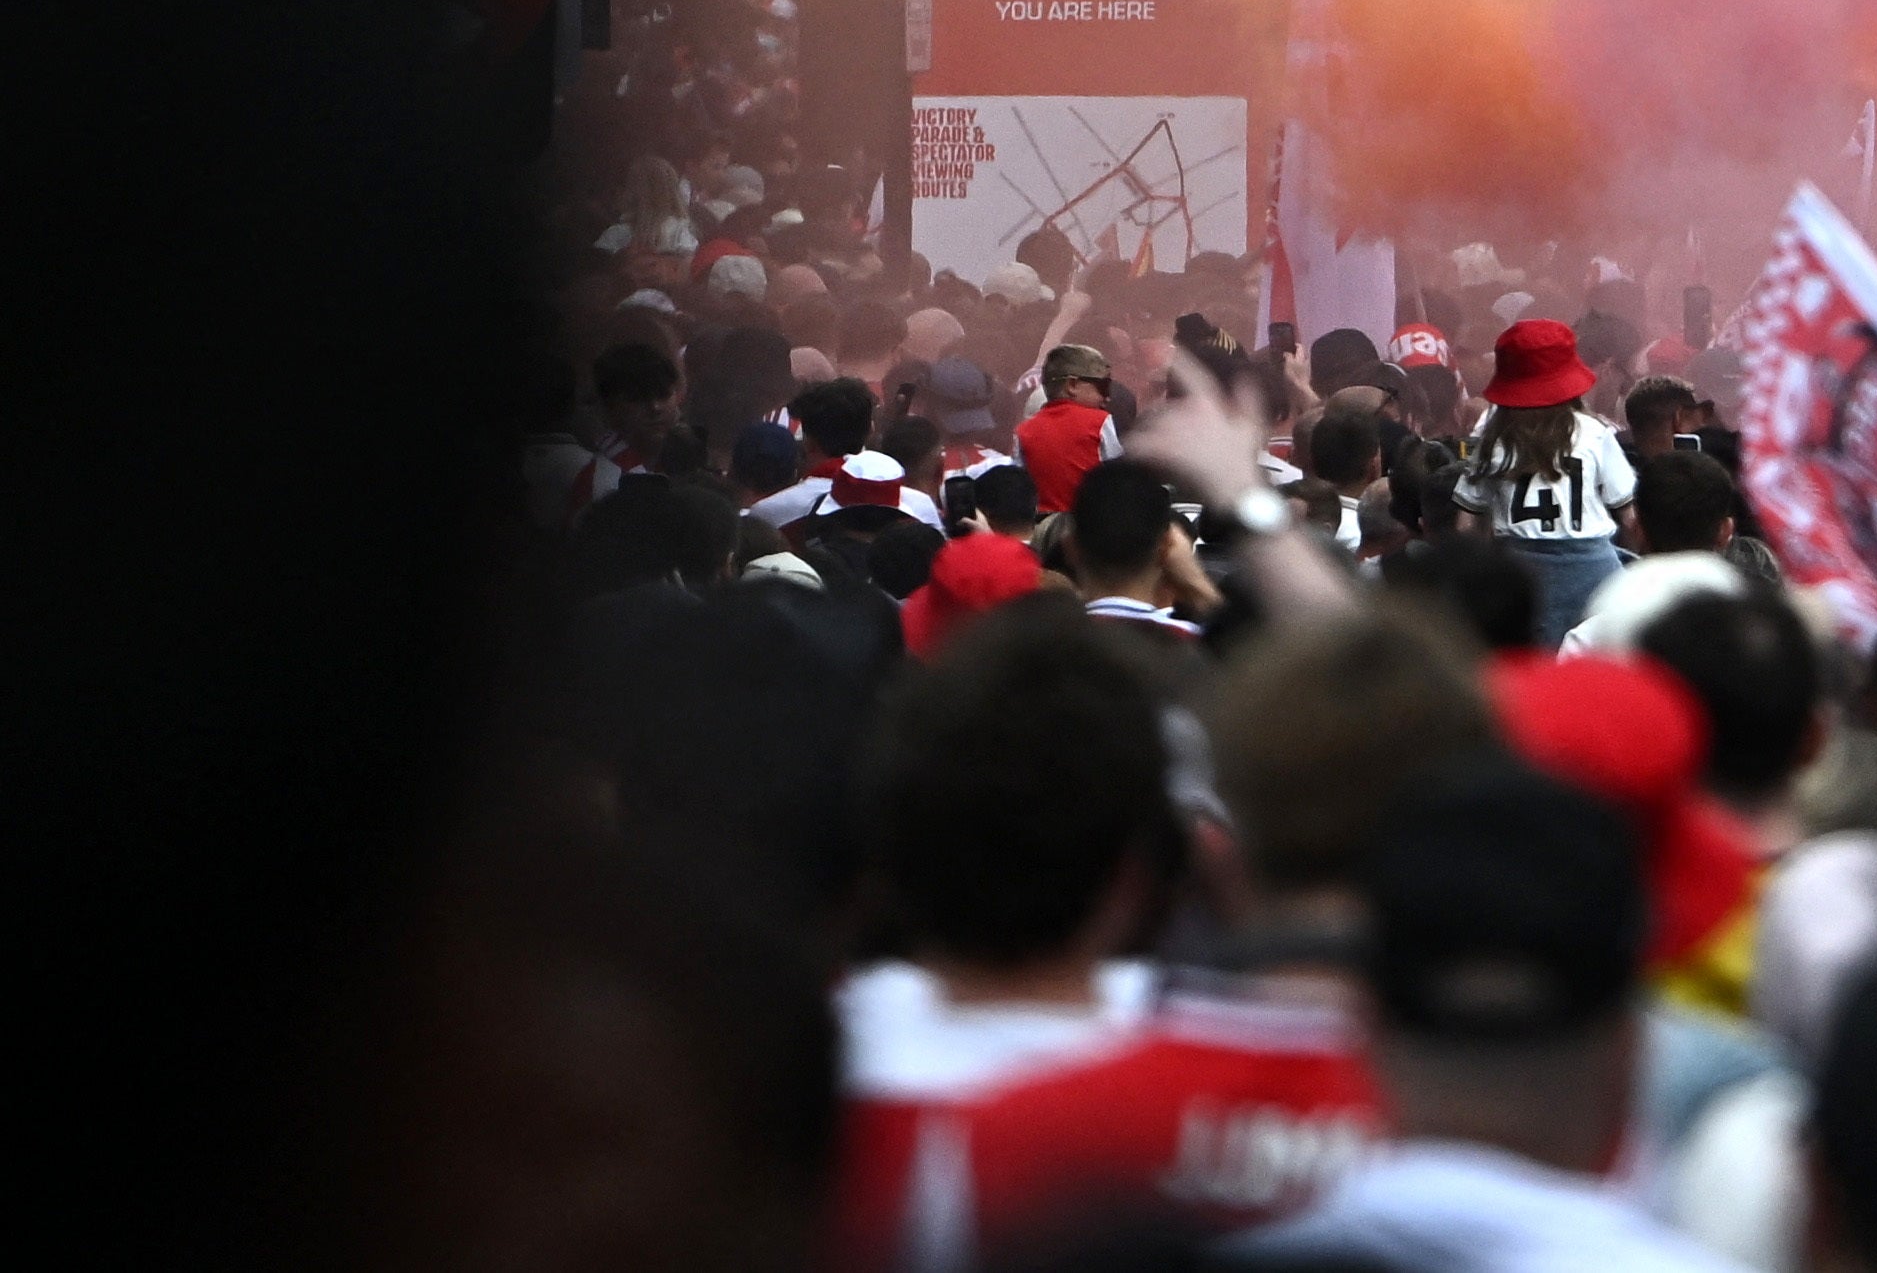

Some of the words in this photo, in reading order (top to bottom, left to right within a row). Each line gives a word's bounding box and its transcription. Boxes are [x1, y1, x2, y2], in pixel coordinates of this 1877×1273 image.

[996, 1, 1044, 21] YOU
[1048, 1, 1093, 21] ARE
[1098, 1, 1155, 21] HERE
[912, 108, 977, 126] VICTORY
[912, 126, 971, 143] PARADE
[973, 126, 985, 143] &
[912, 144, 996, 161] SPECTATOR
[912, 162, 975, 180] VIEWING
[1511, 456, 1582, 532] 41
